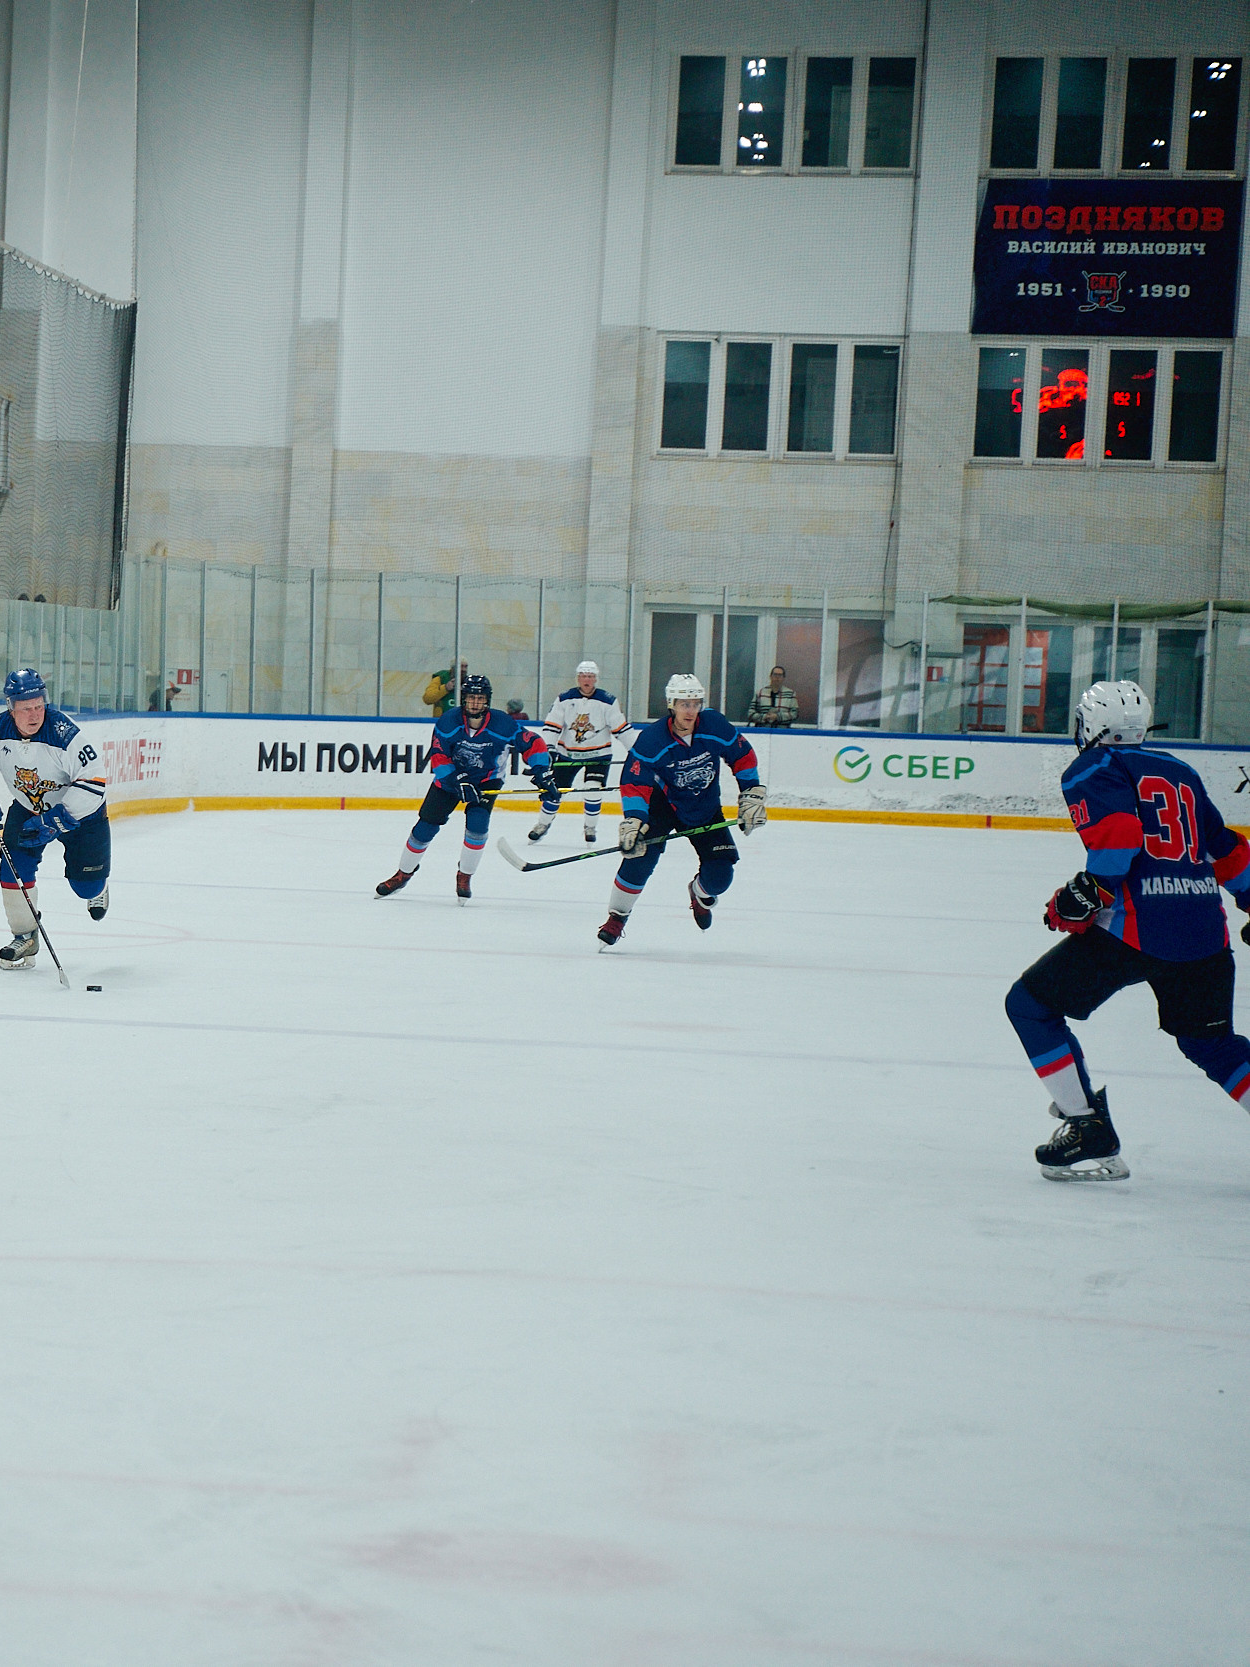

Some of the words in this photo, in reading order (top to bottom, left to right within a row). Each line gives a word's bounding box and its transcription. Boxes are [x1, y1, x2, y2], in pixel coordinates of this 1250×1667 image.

[993, 204, 1225, 234] ПОЗДНЯКОВ
[1007, 238, 1097, 254] ВАСИЛИЙ
[1102, 241, 1207, 256] ИВАНОВИЧ
[1017, 282, 1063, 297] 1951
[1140, 284, 1191, 298] 1990
[257, 742, 306, 772] МЫ
[883, 754, 975, 780] СБЕР
[1068, 798, 1091, 829] 31
[1138, 775, 1203, 865] 31
